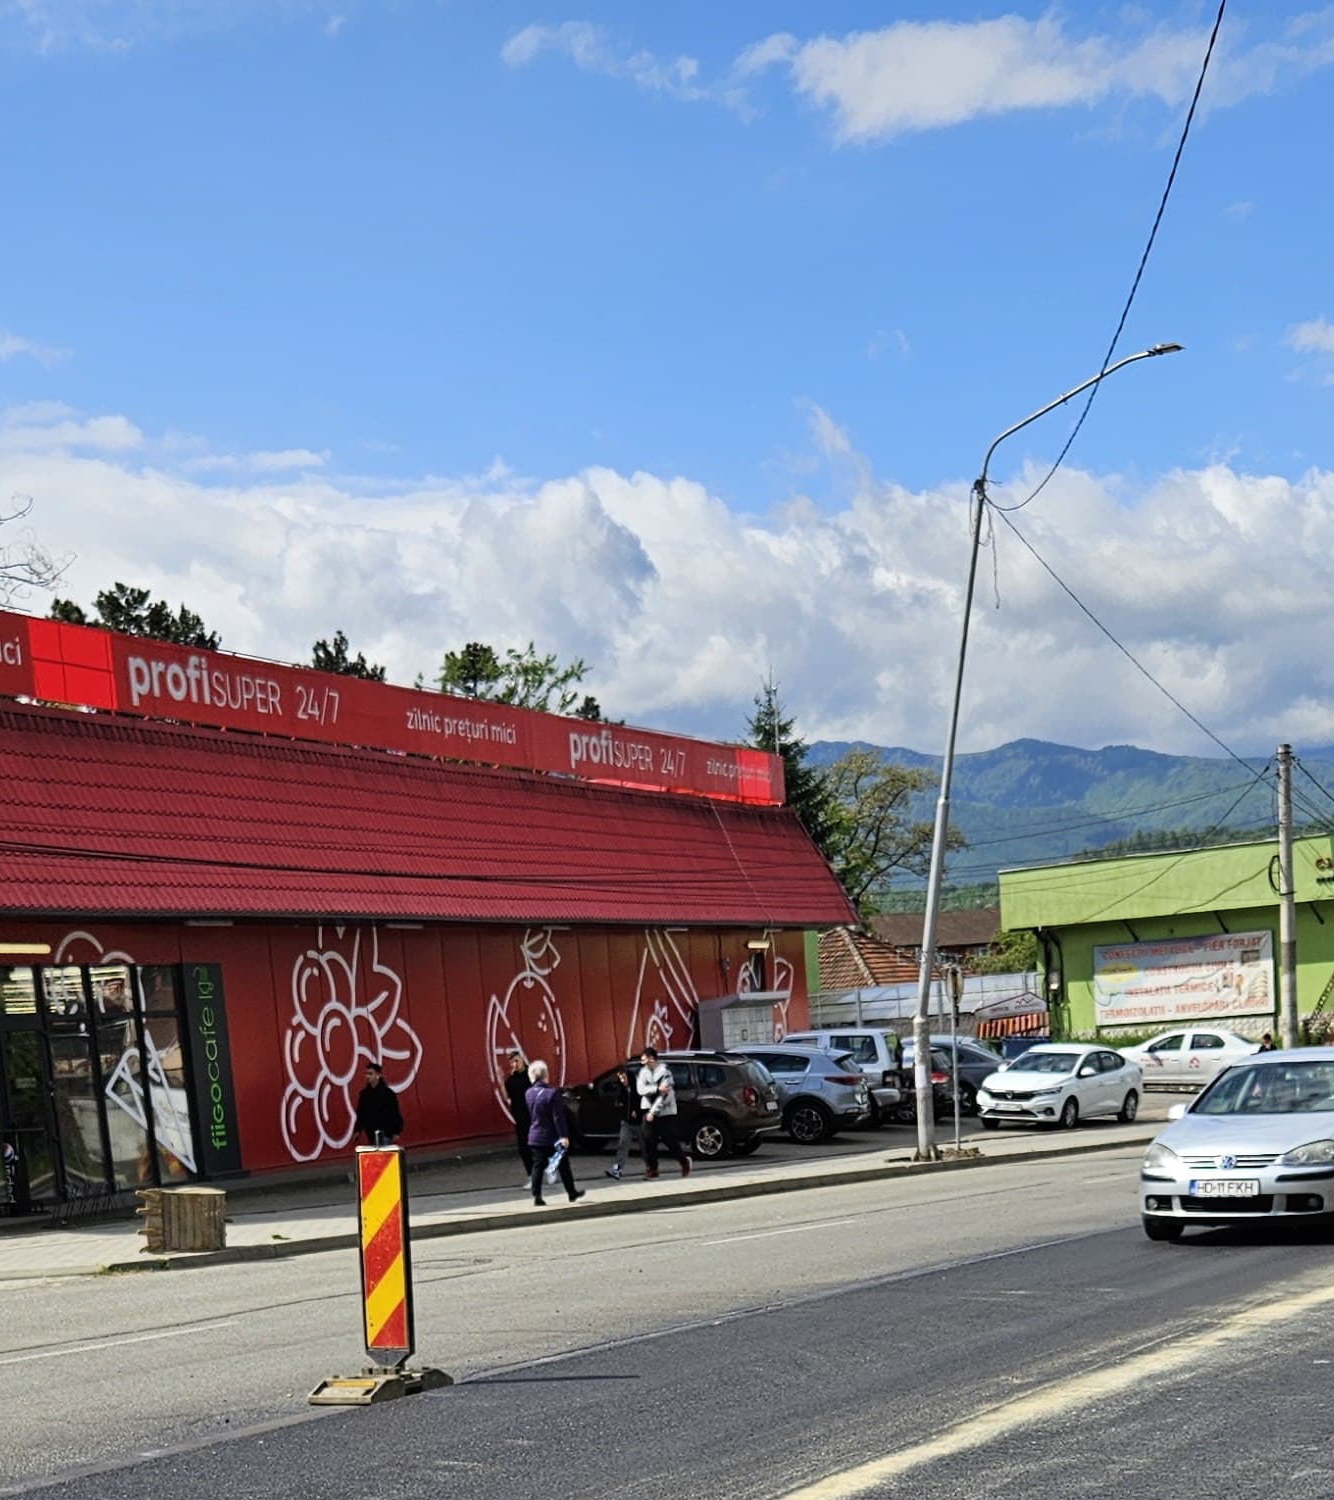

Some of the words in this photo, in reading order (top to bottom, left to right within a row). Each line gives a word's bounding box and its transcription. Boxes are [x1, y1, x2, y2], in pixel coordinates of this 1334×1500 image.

[296, 686, 340, 727] 24/7
[406, 707, 442, 733] zilnic
[443, 718, 489, 743] prețuri
[491, 722, 517, 745] mici
[660, 747, 686, 778] 24/7
